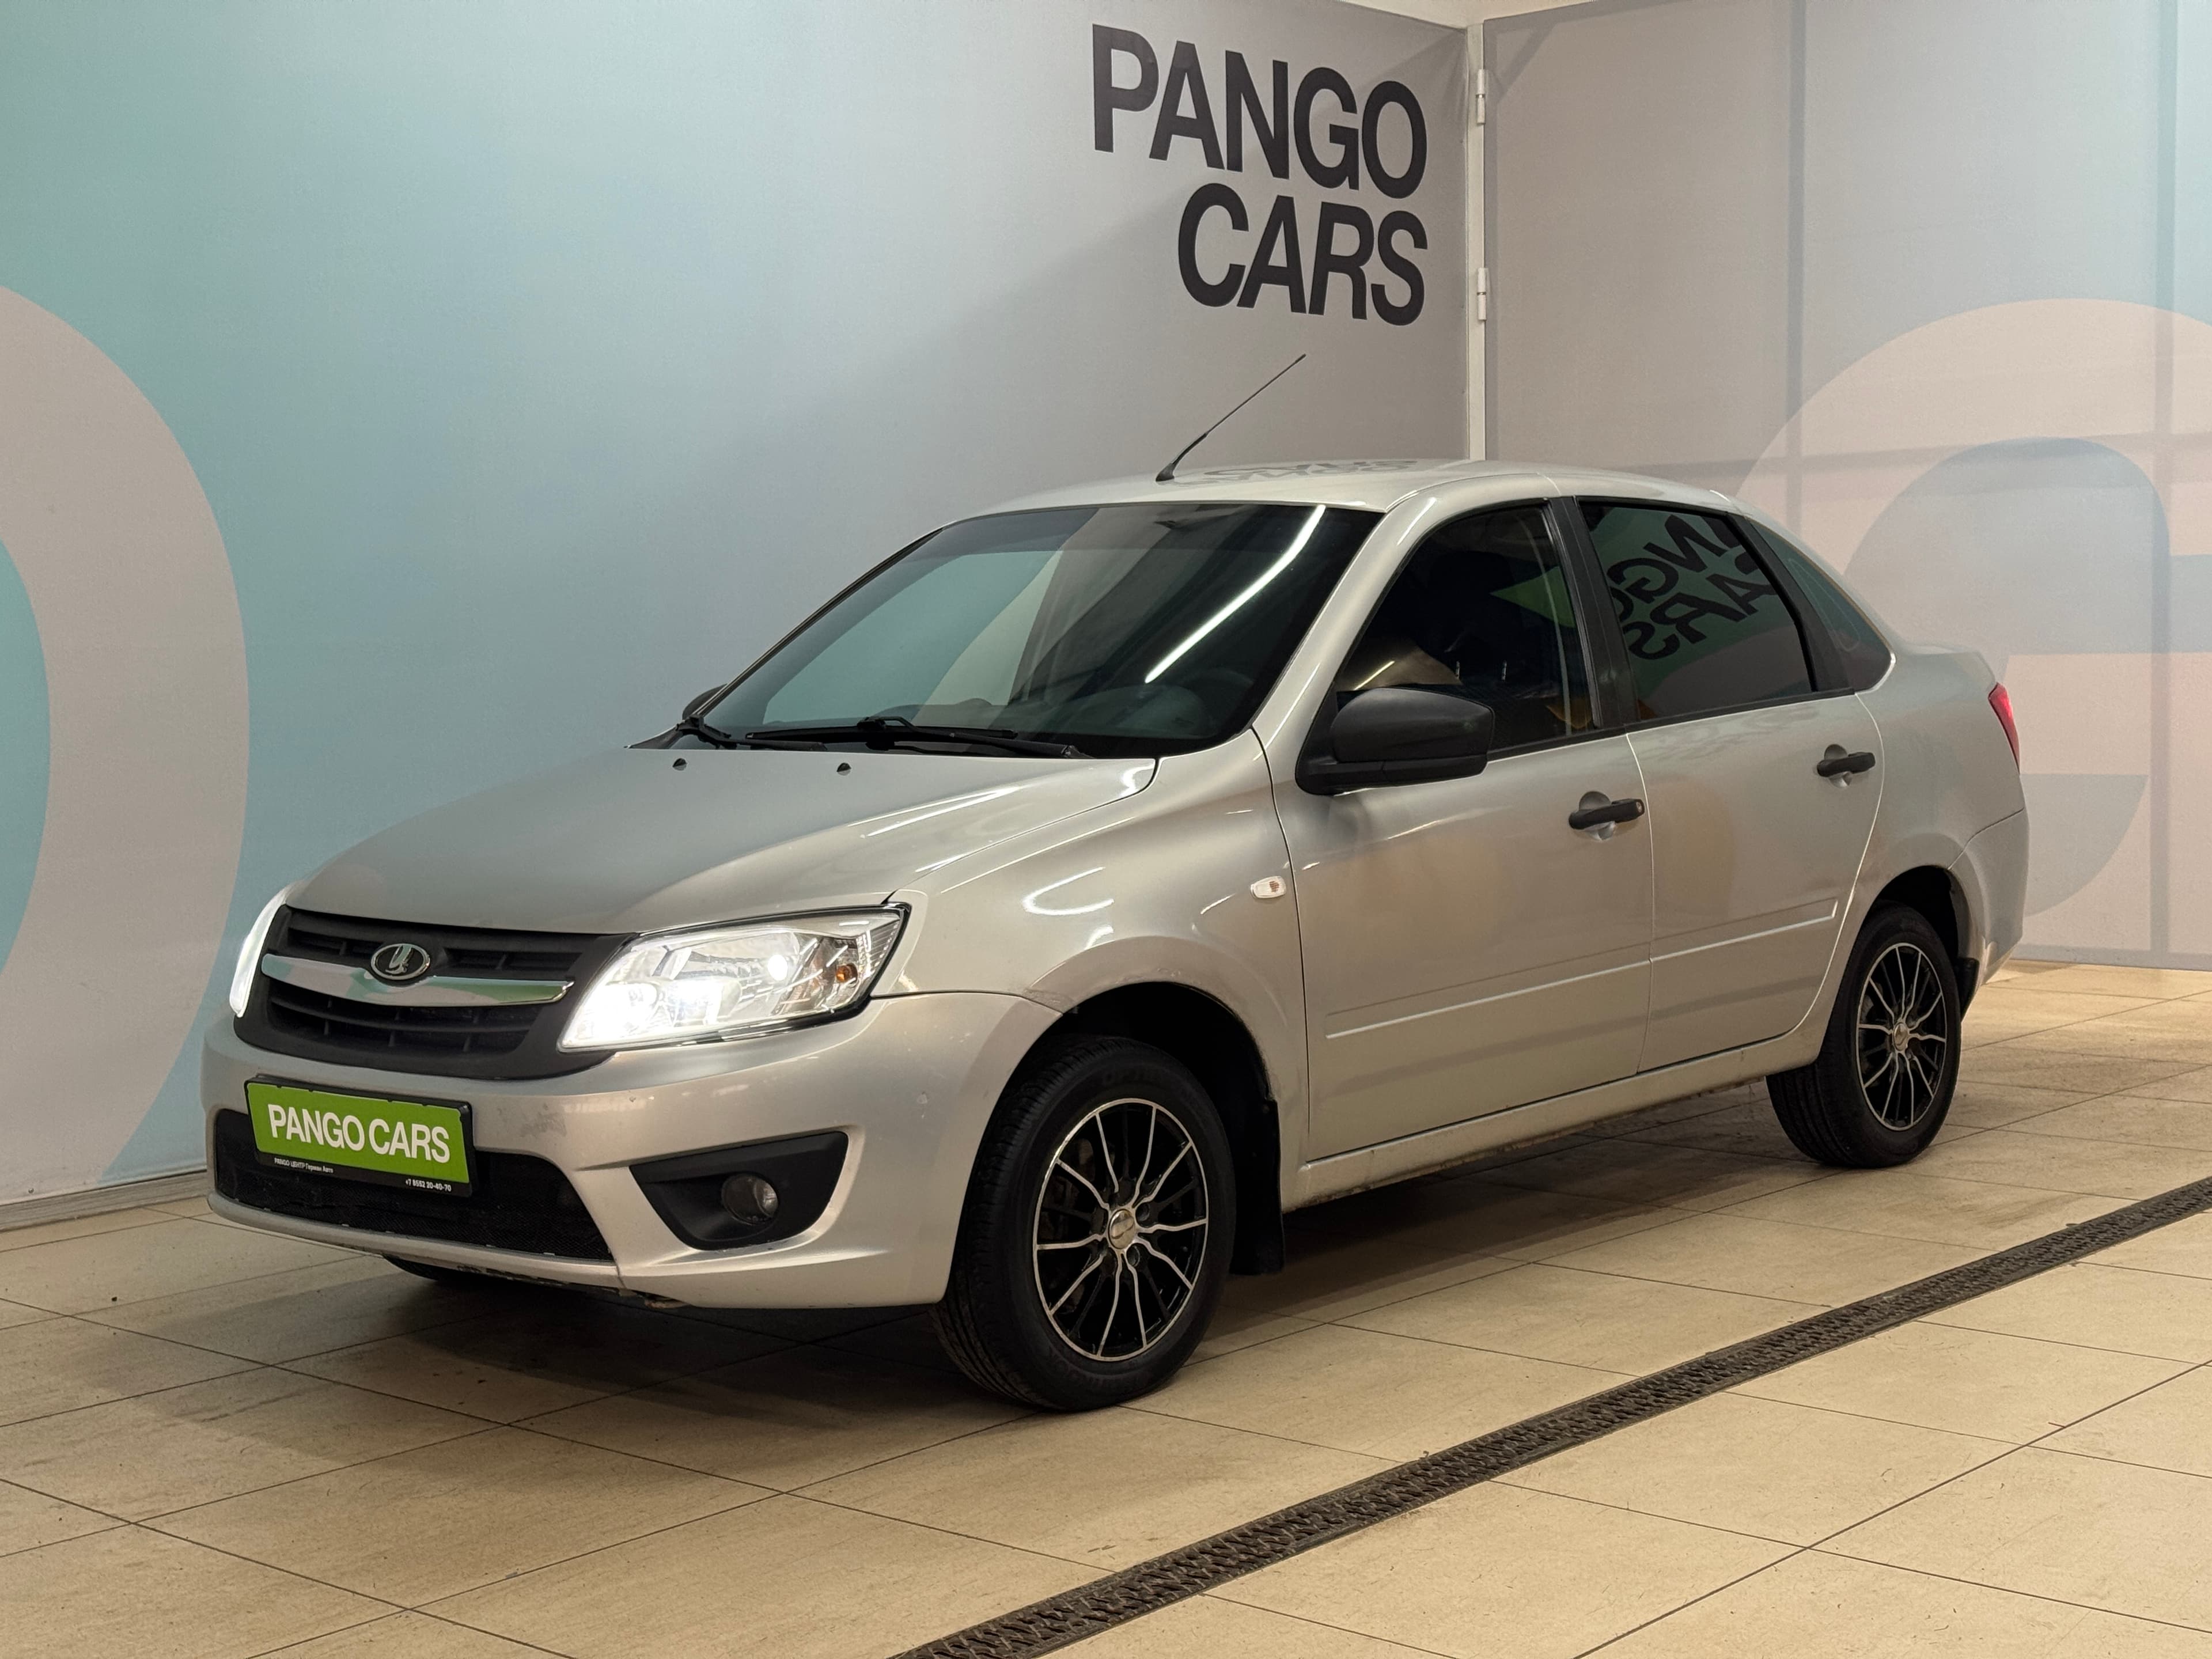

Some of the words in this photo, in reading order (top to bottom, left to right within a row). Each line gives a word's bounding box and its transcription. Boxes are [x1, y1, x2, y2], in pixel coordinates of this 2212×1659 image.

[1092, 23, 1427, 199] PANGO
[1178, 183, 1428, 326] CARS
[267, 1104, 365, 1151] PANGO
[369, 1118, 450, 1164] CARS
[274, 1157, 290, 1166] PANGO
[290, 1160, 305, 1169] ЦЕНТР
[426, 1181, 452, 1192] 20-40-70
